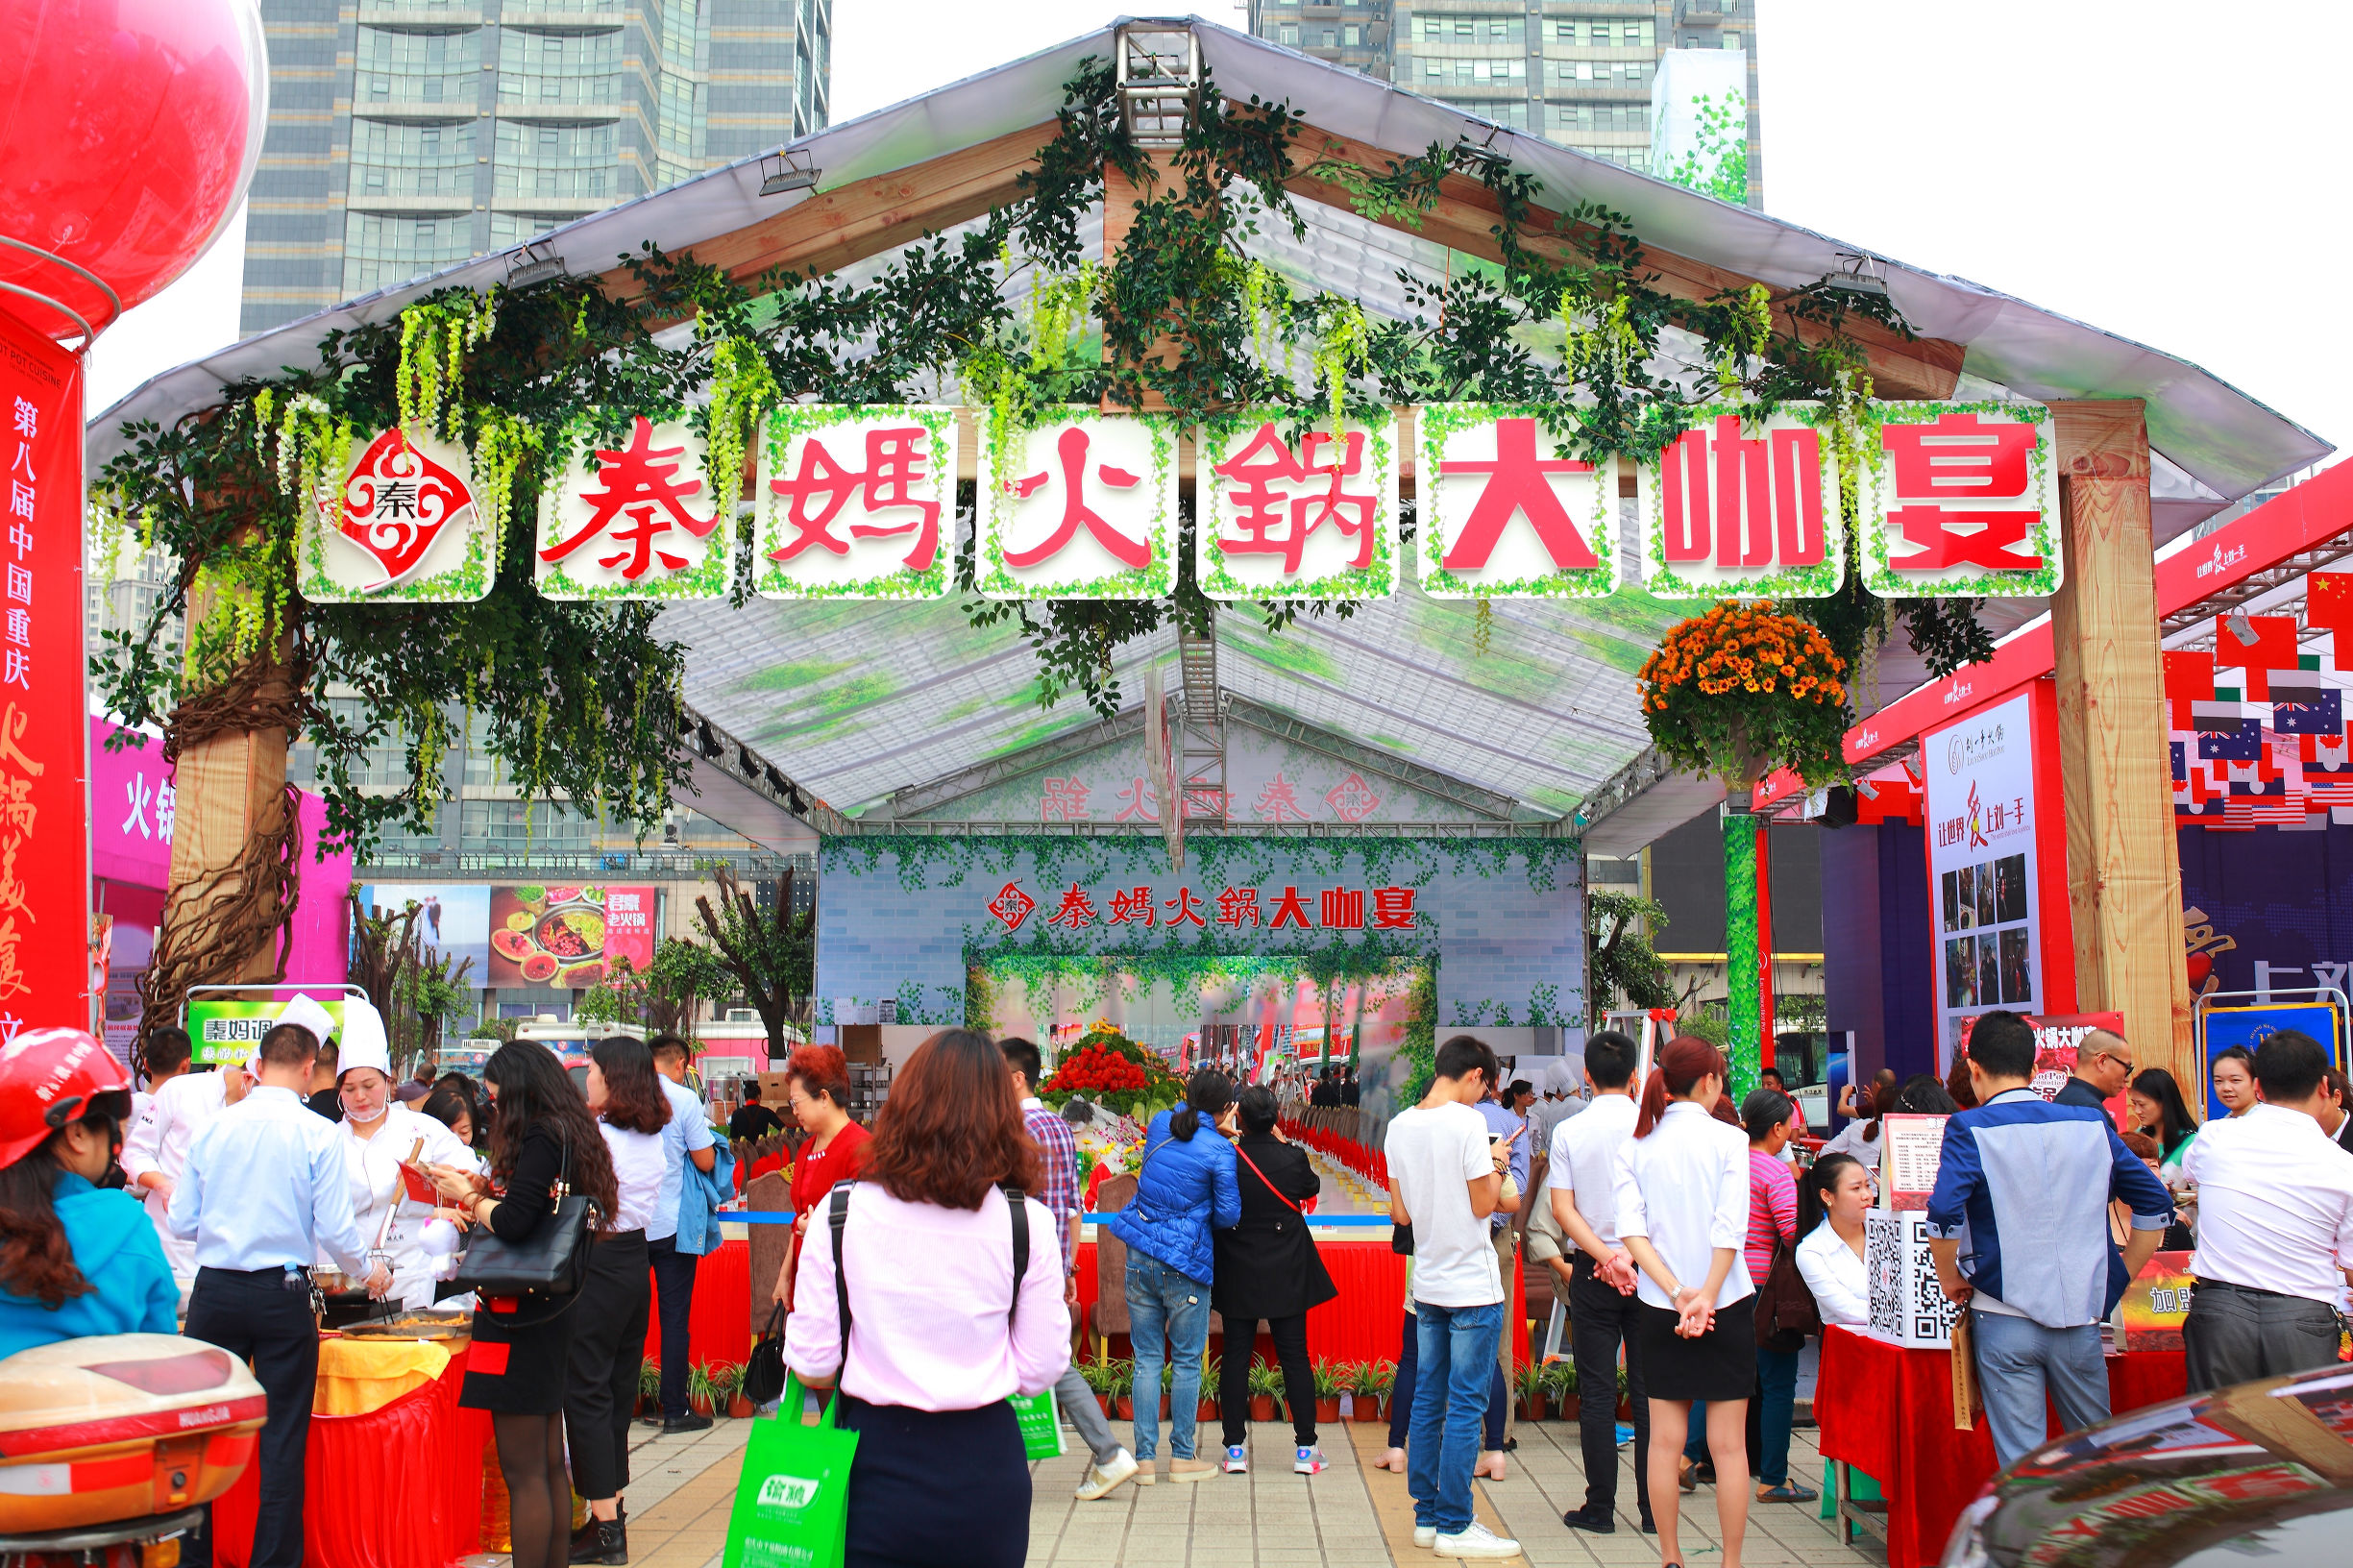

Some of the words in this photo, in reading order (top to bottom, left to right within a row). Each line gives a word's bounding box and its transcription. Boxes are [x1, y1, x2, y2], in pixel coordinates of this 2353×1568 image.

[29, 362, 61, 389] CUISINE
[376, 481, 416, 519] 秦
[3, 395, 39, 691] 第八届中国重庆
[1938, 779, 2025, 853] 让世界爱上刘一手
[607, 913, 646, 926] 老火锅
[1048, 882, 1417, 930] 秦媽火鍋大咖宴
[205, 1019, 278, 1041] 秦妈调
